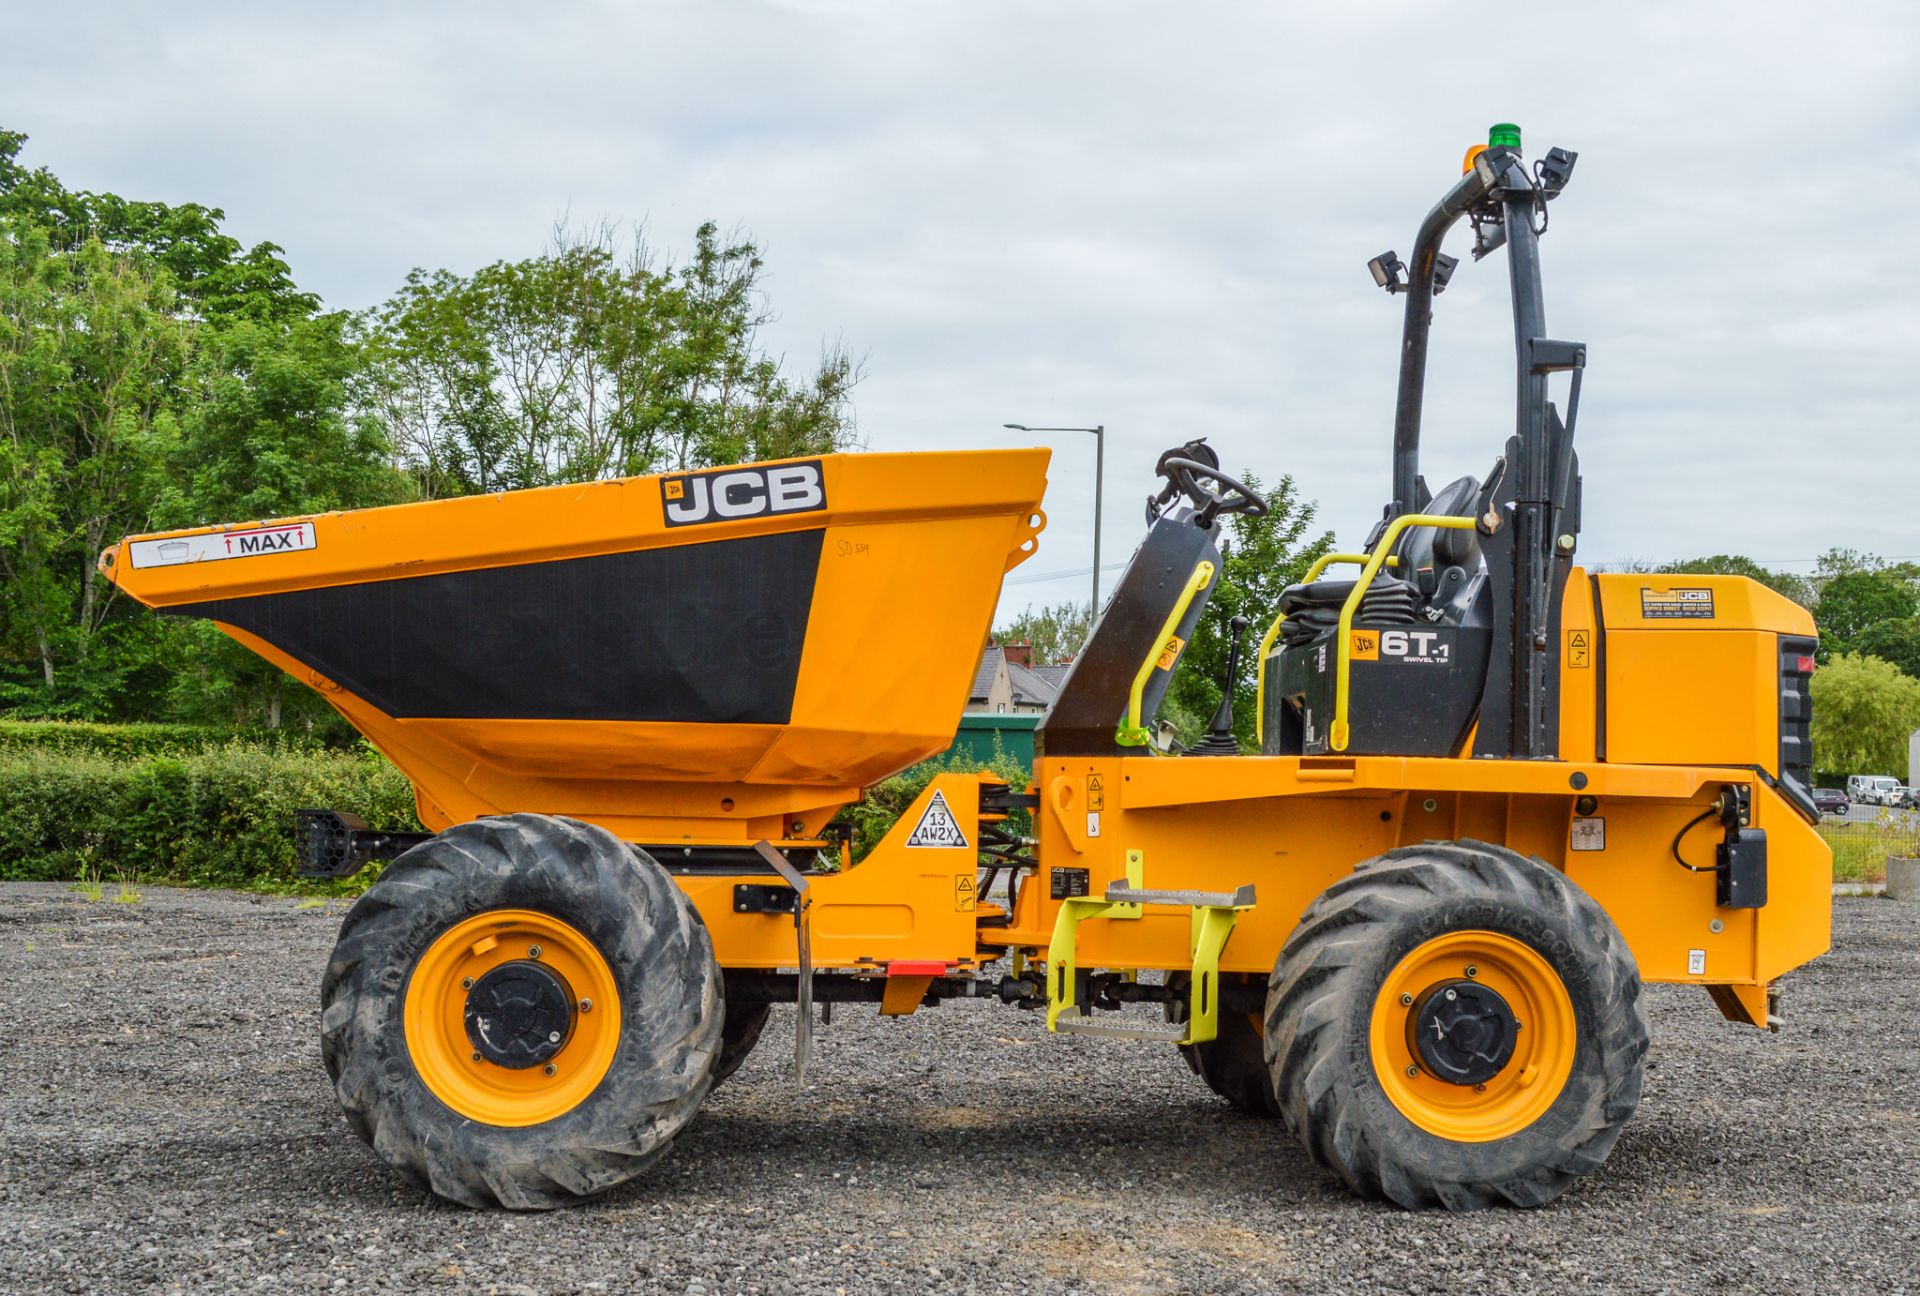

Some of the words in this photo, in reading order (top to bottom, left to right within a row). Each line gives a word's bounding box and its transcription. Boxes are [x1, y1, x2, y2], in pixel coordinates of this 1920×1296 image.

[667, 466, 822, 522] JCB
[239, 532, 293, 553] MAX
[1680, 592, 1708, 600] JCB
[1355, 636, 1375, 652] JCB
[930, 812, 946, 826] 13
[921, 827, 954, 841] AW2X
